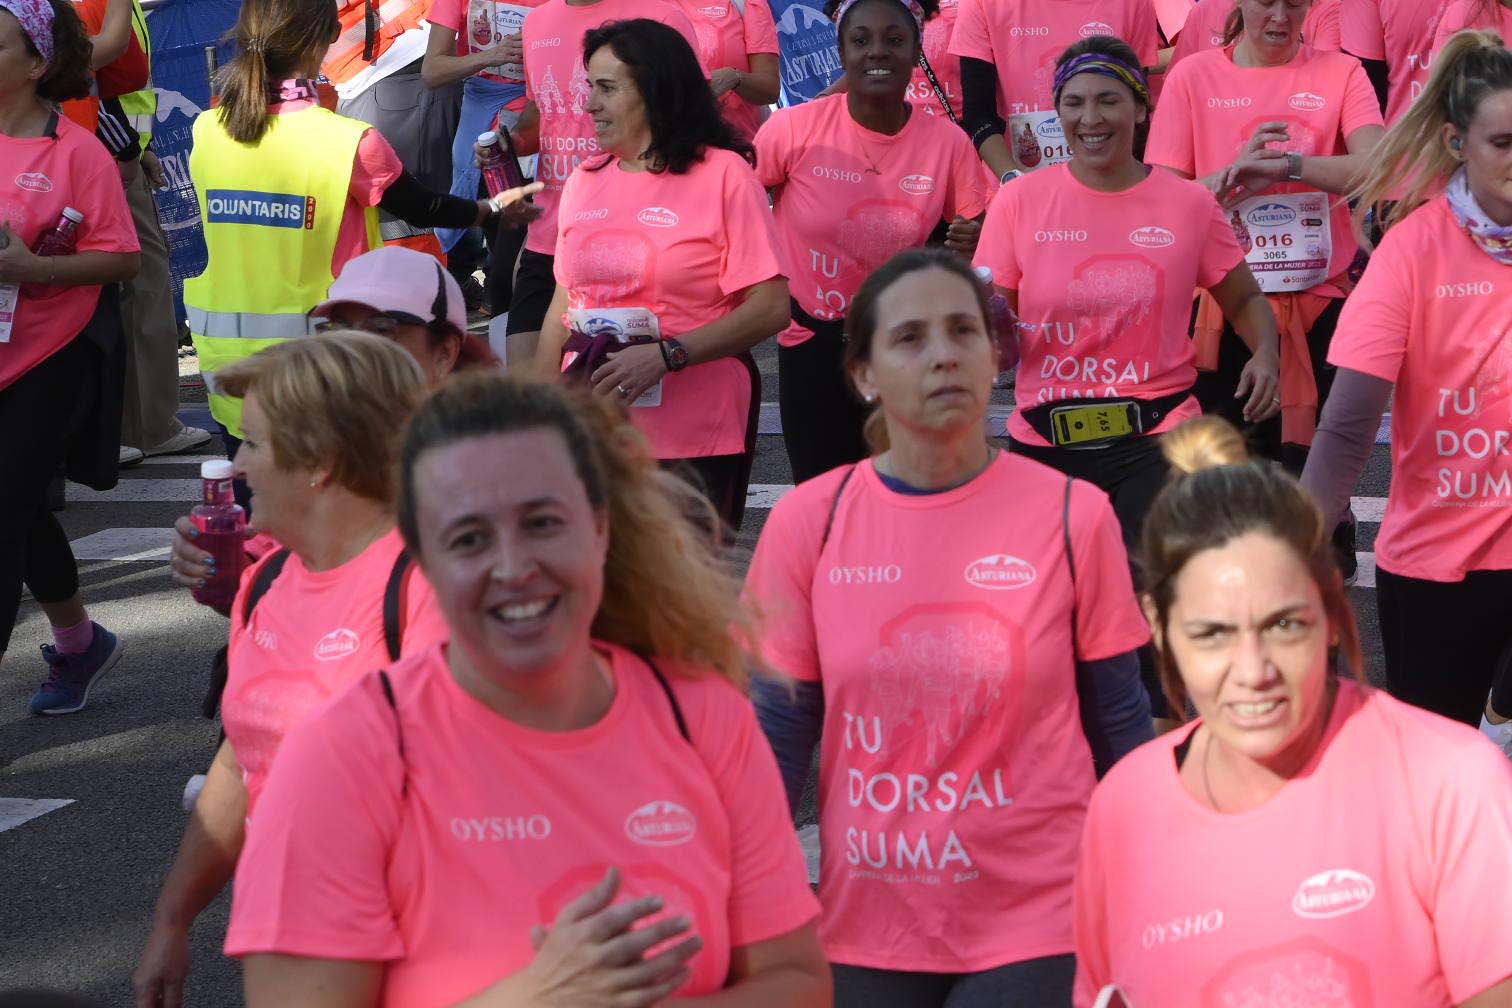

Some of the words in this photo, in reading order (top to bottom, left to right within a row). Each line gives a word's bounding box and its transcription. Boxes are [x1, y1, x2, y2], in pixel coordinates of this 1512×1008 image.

[1010, 27, 1048, 37] OYSHO
[1408, 55, 1431, 71] TU
[1208, 97, 1251, 108] OYSHO
[540, 137, 553, 150] TU
[557, 137, 597, 150] DORS
[813, 166, 861, 184] OYSHO
[1251, 211, 1293, 222] ASTURIANA
[1035, 230, 1087, 242] OYSHO
[1255, 233, 1294, 248] 016
[809, 249, 838, 278] TU
[1263, 251, 1287, 260] 3065
[1273, 262, 1283, 270] LA
[1284, 262, 1306, 270] MUJER
[1436, 280, 1493, 298] OYSHO
[1042, 322, 1074, 345] TU
[1439, 387, 1476, 417] TU
[829, 564, 902, 585] OYSHO
[970, 567, 1032, 582] ASTURIANA
[845, 712, 882, 754] TU
[849, 768, 1013, 813] DORSAL
[451, 814, 552, 841] OYSHO
[847, 827, 972, 870] SUMA
[1142, 908, 1223, 949] OYSHO
